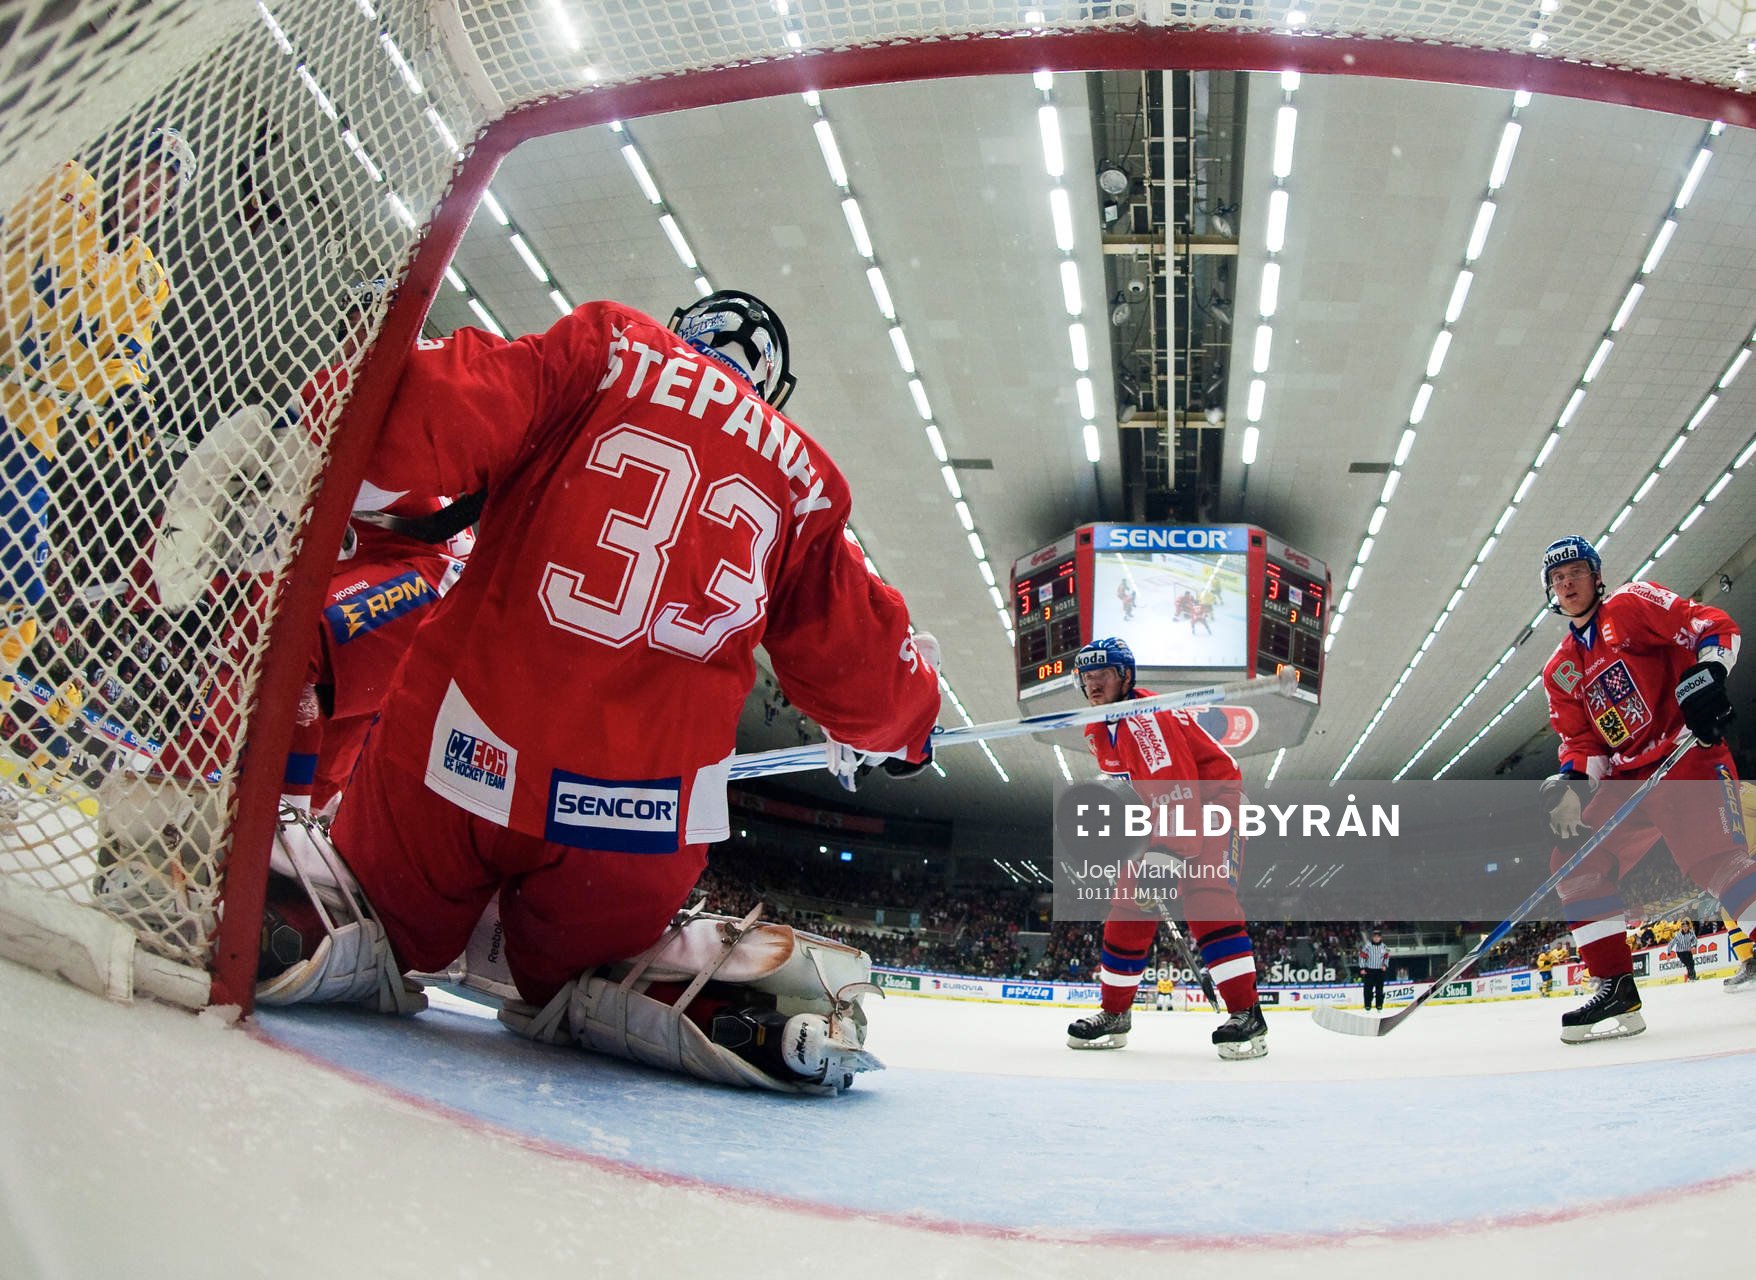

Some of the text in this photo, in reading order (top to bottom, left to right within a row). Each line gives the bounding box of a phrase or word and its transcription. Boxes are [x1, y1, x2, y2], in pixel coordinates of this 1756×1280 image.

[538, 422, 782, 663] 33
[1109, 528, 1228, 549] SENCOR
[332, 579, 370, 601] Reebok
[366, 576, 428, 618] RPM
[1268, 579, 1279, 600] 3
[1022, 595, 1030, 616] 3
[1044, 606, 1051, 620] 3
[1290, 609, 1298, 623] 3
[1038, 660, 1063, 680] 07:13
[448, 732, 507, 776] CZECH
[444, 756, 507, 791] ICE HOCKEY TEAM
[557, 792, 673, 821] SENCOR
[1270, 961, 1337, 983] Škoda
[942, 982, 984, 992] EUROVIA
[1302, 992, 1346, 1001] EUROVIA
